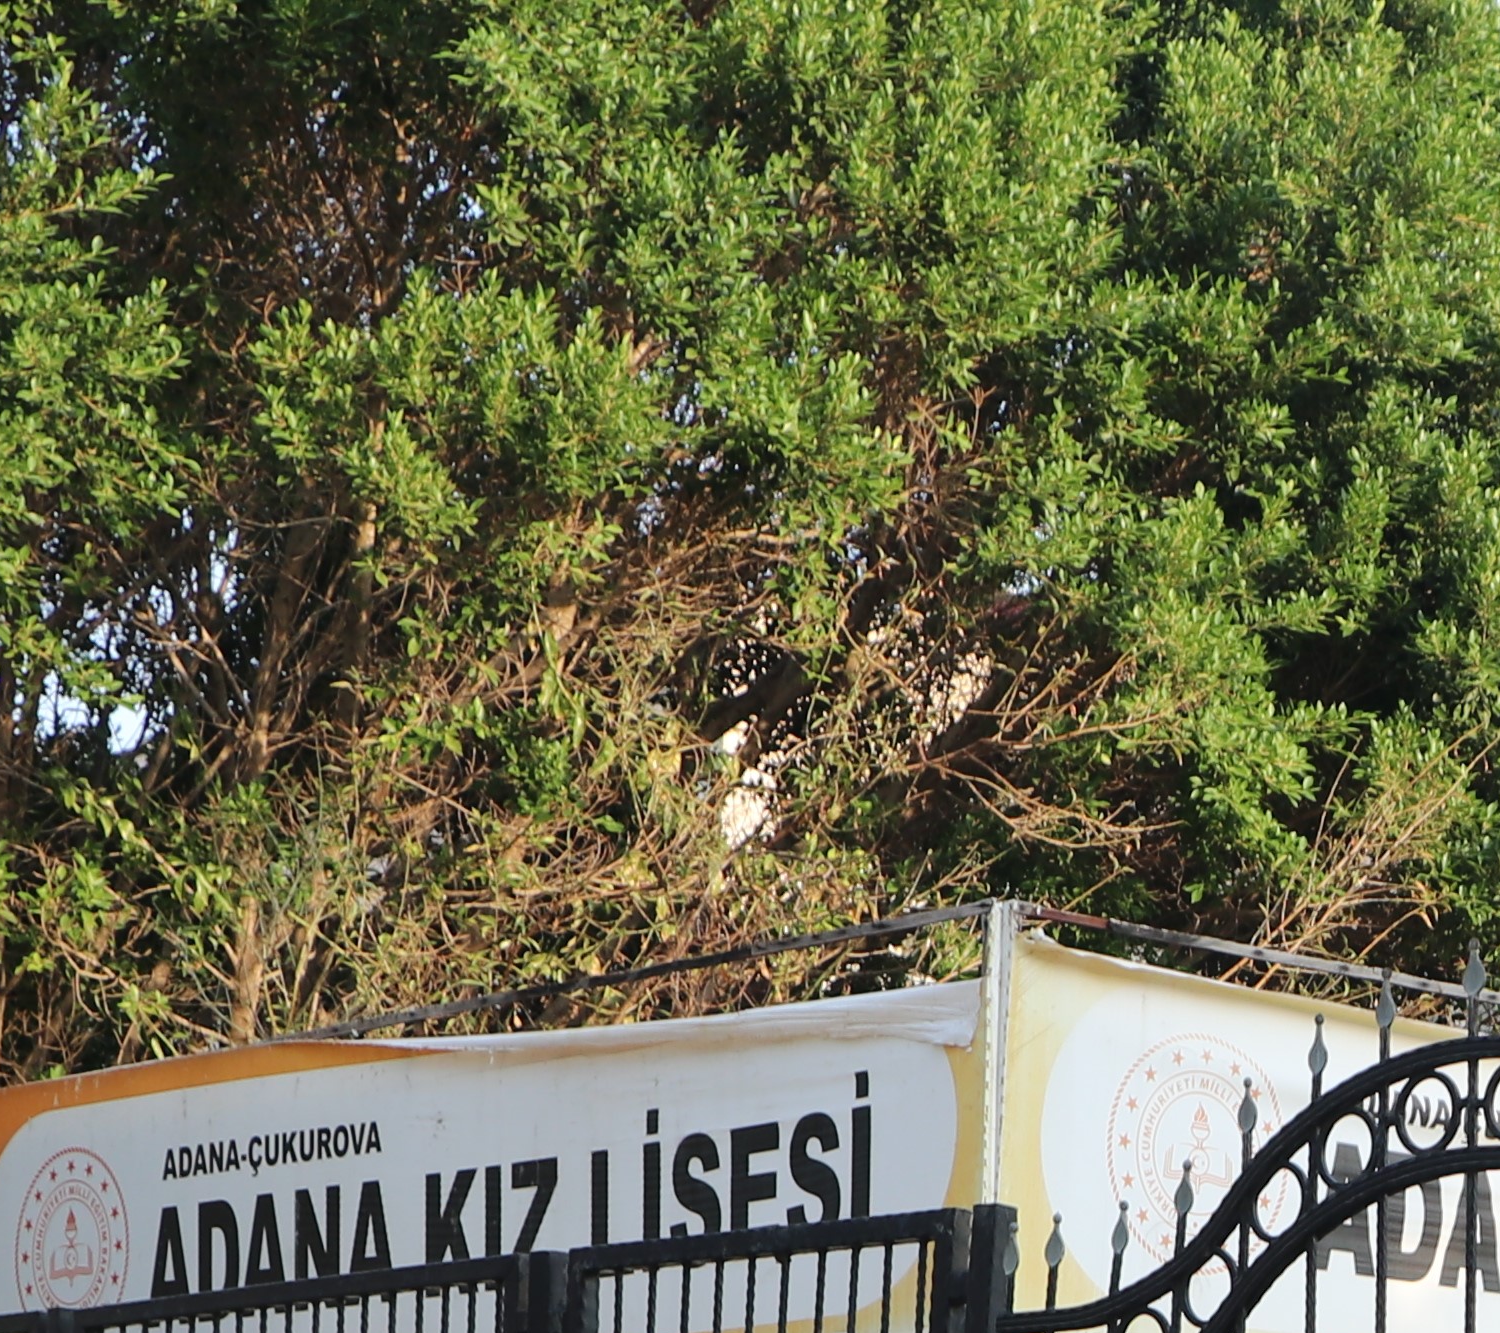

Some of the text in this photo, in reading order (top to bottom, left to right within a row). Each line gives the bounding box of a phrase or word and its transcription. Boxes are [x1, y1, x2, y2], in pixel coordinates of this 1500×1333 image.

[162, 1120, 383, 1178] ADANA-ÇUKUROVA
[1141, 1075, 1196, 1162] CUMHURİYETİ
[1200, 1077, 1233, 1101] MİLLİ
[69, 1184, 91, 1199] MİLLİ
[151, 1179, 393, 1308] ADANA
[425, 1157, 558, 1296] KIZ
